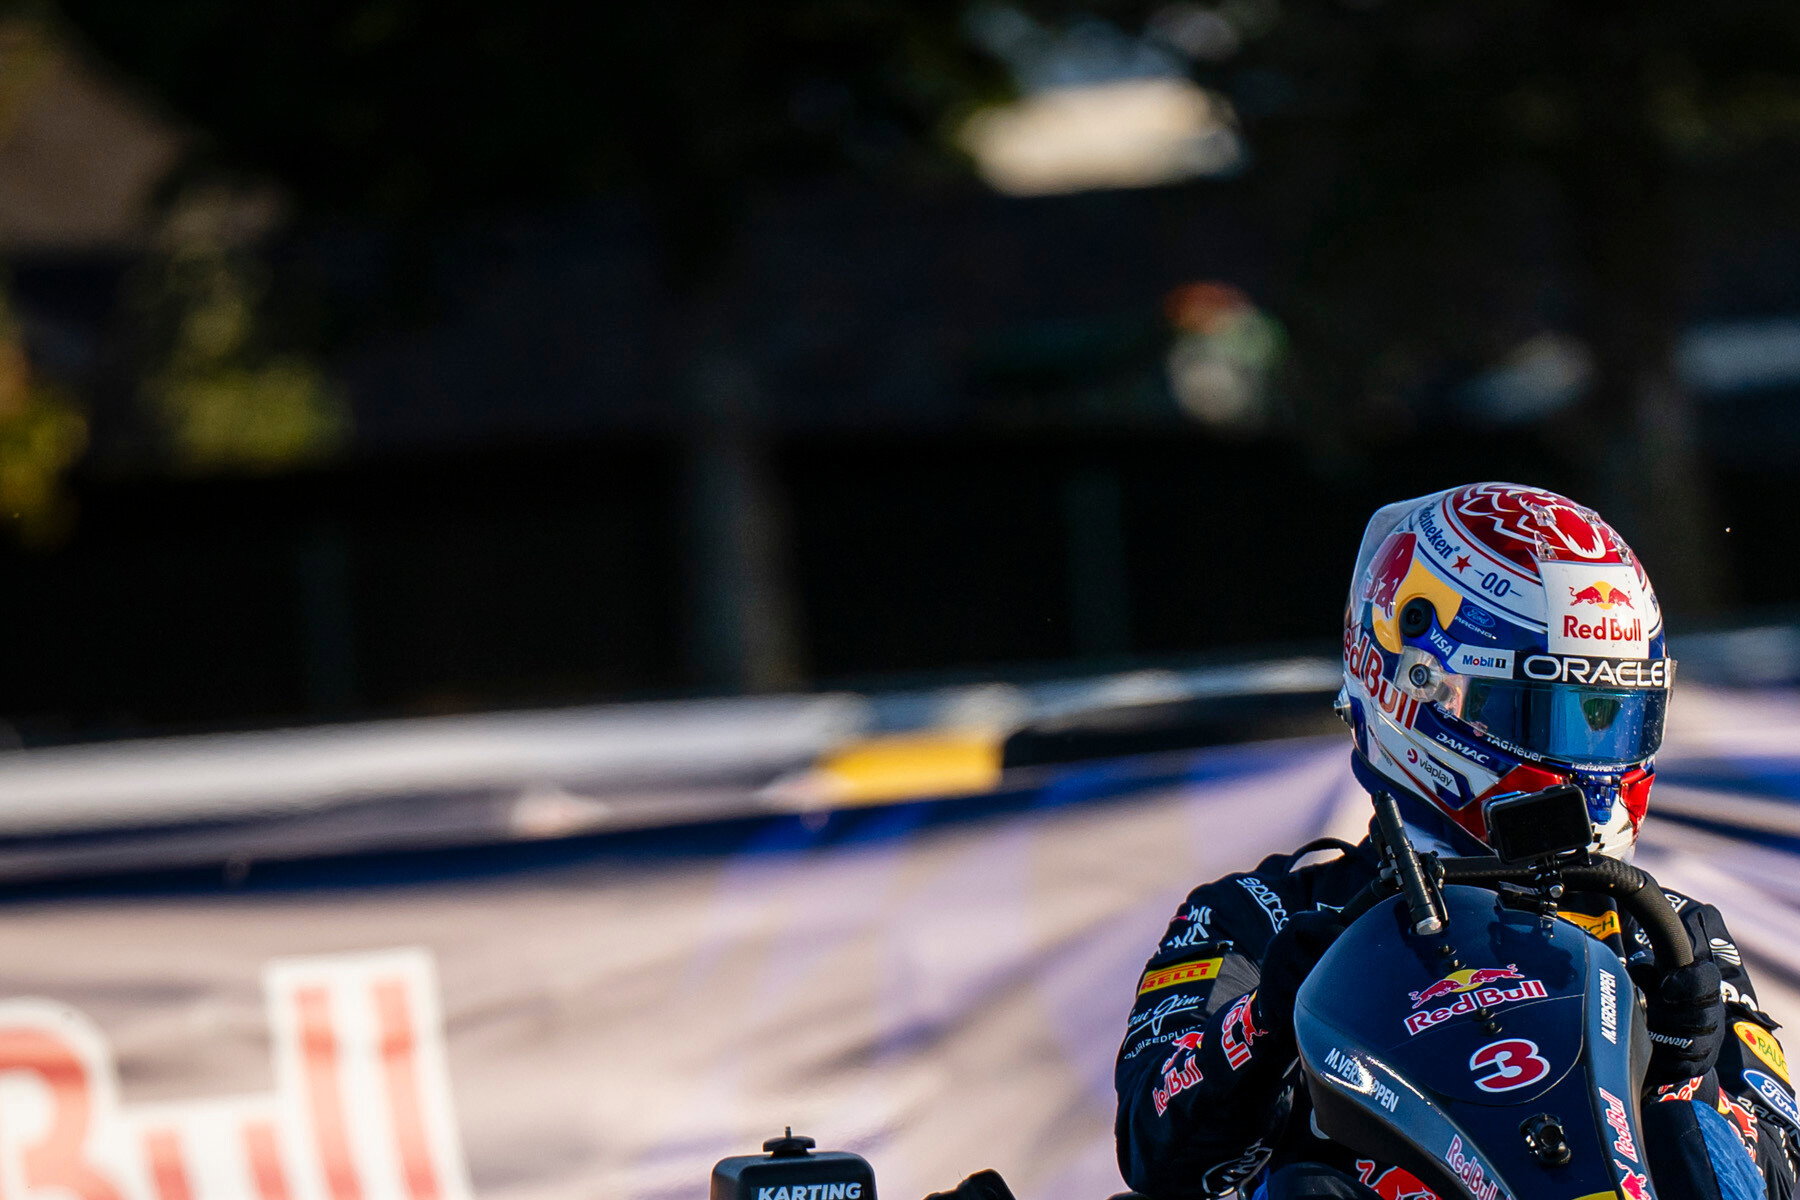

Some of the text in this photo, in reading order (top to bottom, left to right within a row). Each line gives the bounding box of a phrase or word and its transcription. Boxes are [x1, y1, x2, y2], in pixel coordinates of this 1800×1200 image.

[1429, 628, 1454, 656] VISA
[1564, 615, 1642, 642] Red Bull
[1462, 655, 1494, 668] Mobil
[1523, 655, 1664, 688] ORACLE
[1343, 628, 1421, 731] ed Bull
[1436, 732, 1490, 764] DAMAC
[1419, 757, 1453, 787] viaplay
[1140, 963, 1210, 991] RELLI
[1128, 1008, 1150, 1028] aui
[1404, 980, 1549, 1036] Red Bull
[1124, 1023, 1202, 1060] OLARIZEDPL
[1757, 1037, 1788, 1071] RAUC
[1167, 1054, 1203, 1097] Bull
[1324, 1047, 1400, 1113] M.VERSPPEN
[1470, 1038, 1550, 1093] 3
[1599, 1087, 1639, 1163] Red Bull
[1445, 1133, 1477, 1185] Red
